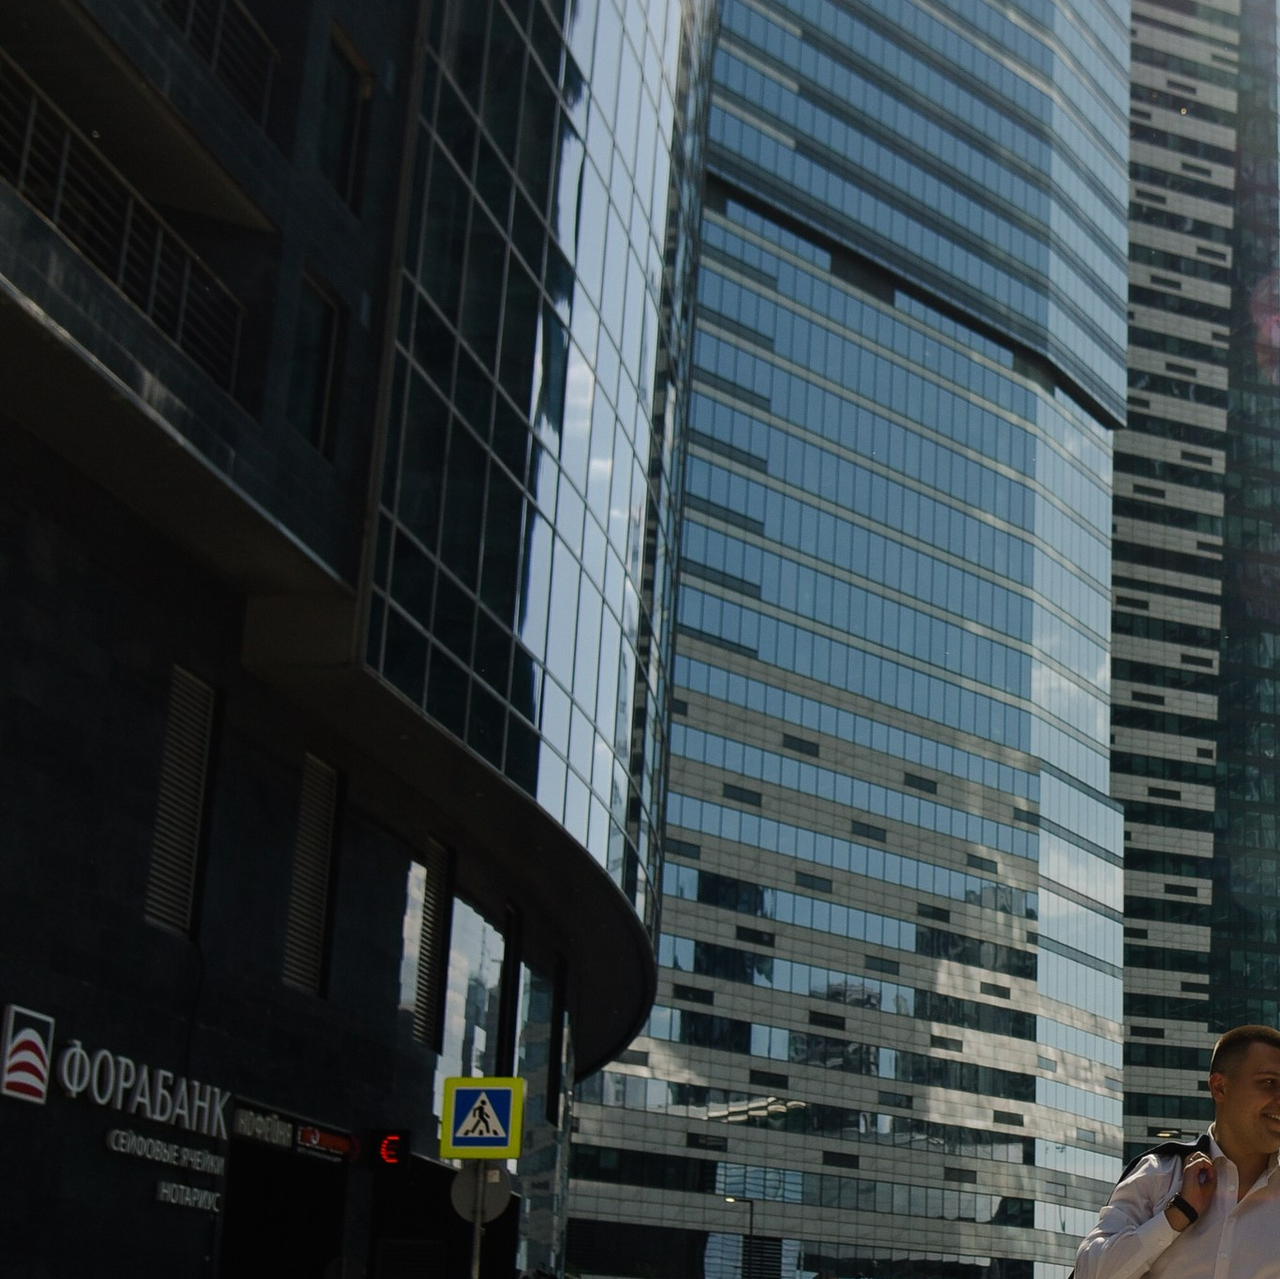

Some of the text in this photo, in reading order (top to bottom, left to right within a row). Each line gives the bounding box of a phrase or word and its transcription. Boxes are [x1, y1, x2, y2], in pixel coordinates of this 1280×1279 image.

[59, 1038, 231, 1140] ФОРАБАНК
[108, 1128, 180, 1166] СЕЙФОВЫЕ
[156, 1179, 222, 1213] НОТАРИУС
